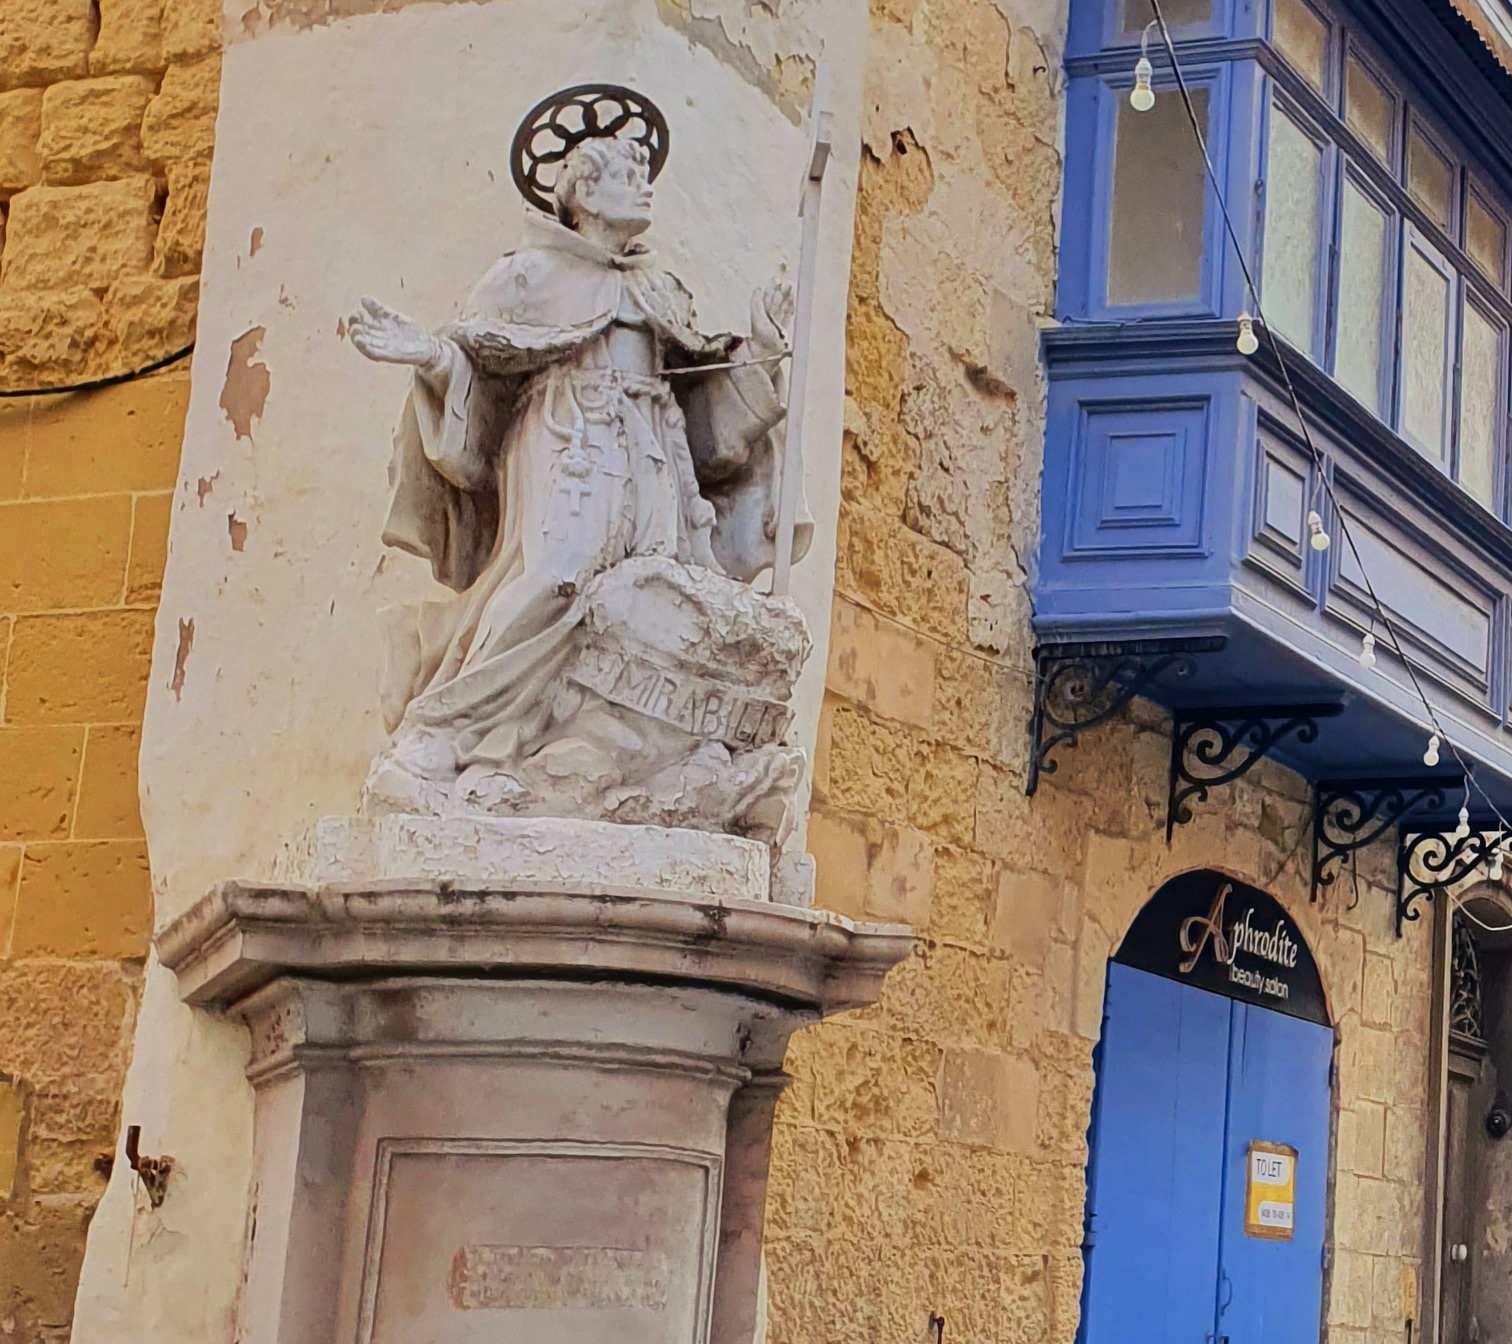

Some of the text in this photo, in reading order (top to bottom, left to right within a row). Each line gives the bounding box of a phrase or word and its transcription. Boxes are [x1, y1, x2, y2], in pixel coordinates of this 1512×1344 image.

[1179, 883, 1298, 973] Aphrodite
[1230, 962, 1289, 999] beauty salon
[1256, 1158, 1282, 1178] TO LET
